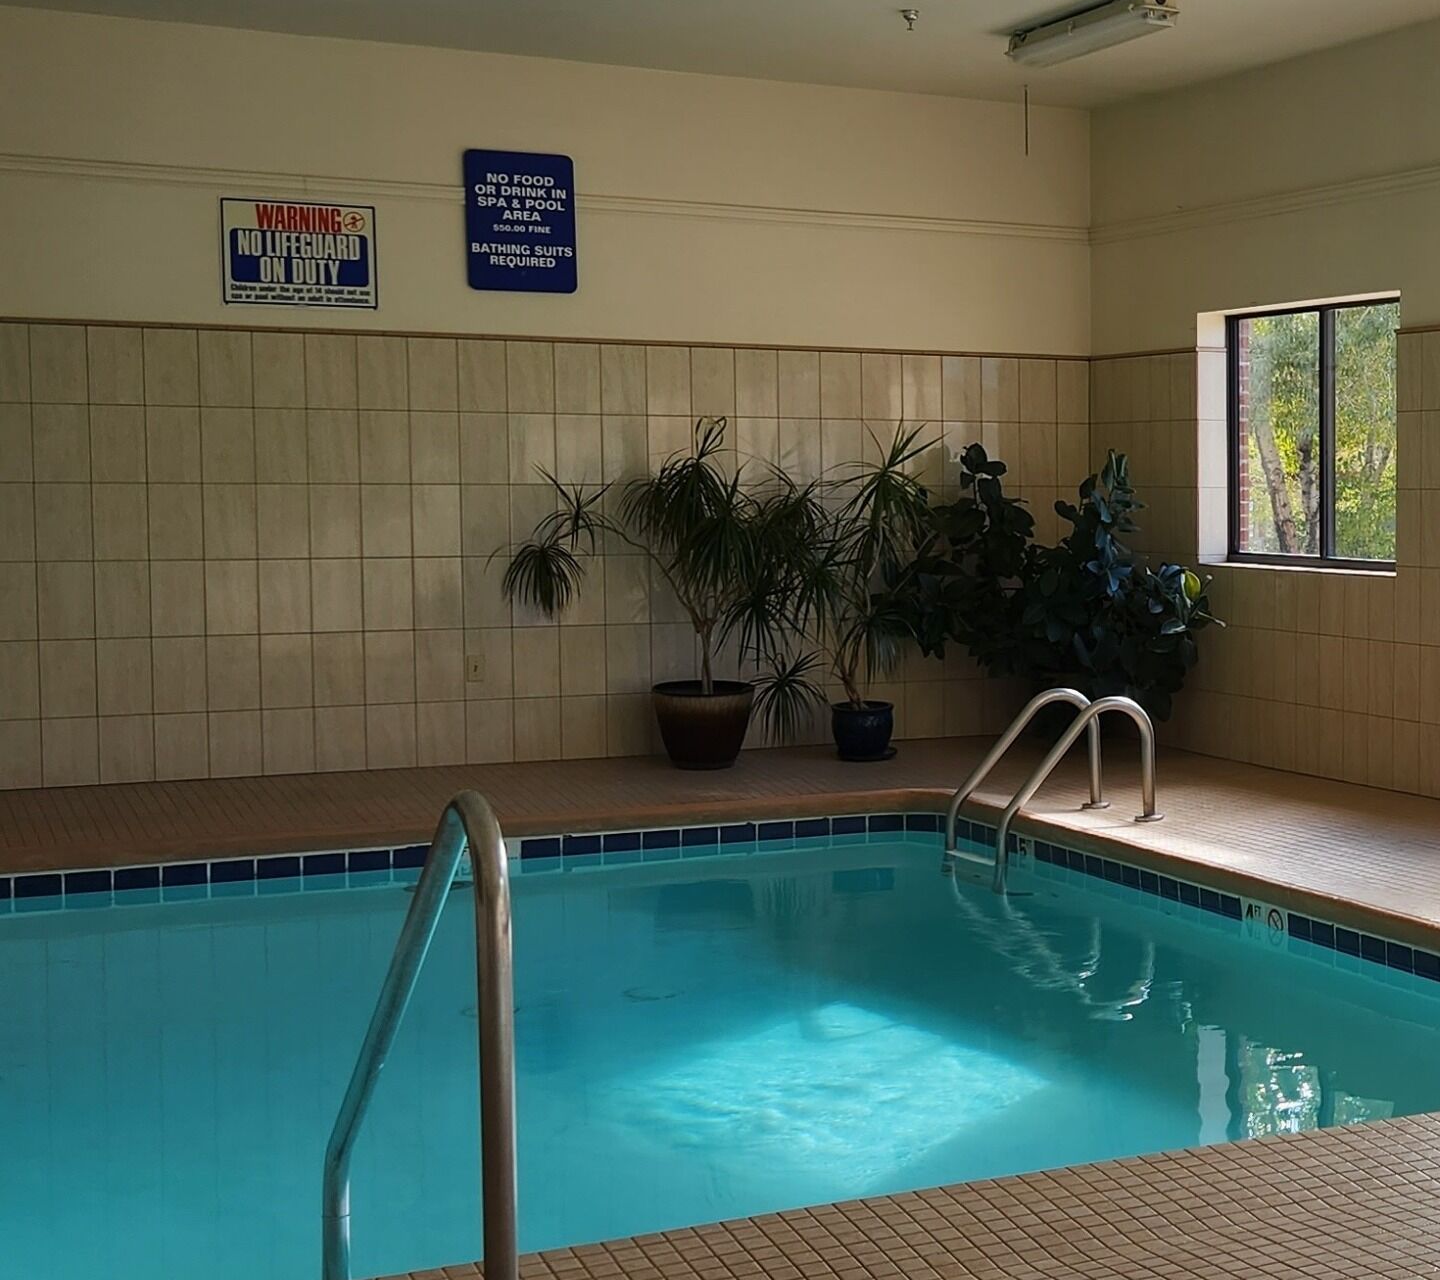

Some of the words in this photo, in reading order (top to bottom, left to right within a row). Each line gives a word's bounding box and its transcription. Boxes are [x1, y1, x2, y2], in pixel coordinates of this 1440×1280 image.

[486, 173, 509, 184] NO
[513, 175, 555, 187] FOOD
[475, 184, 496, 195] OR
[501, 186, 547, 199] DRINK
[551, 189, 567, 199] IN
[477, 196, 507, 208] SPA
[511, 199, 521, 209] &
[525, 200, 565, 211] POOL
[255, 203, 342, 233] WARNING
[502, 210, 541, 222] AREA
[493, 224, 526, 233] $50.00
[528, 226, 552, 234] FINE
[237, 229, 263, 256] NO
[265, 231, 361, 261] LIFEGUARD
[471, 242, 531, 256] BATHING
[534, 245, 573, 258] SUITS
[489, 255, 556, 269] REQUIRED
[259, 256, 286, 283] ON
[291, 258, 341, 286] DUTY
